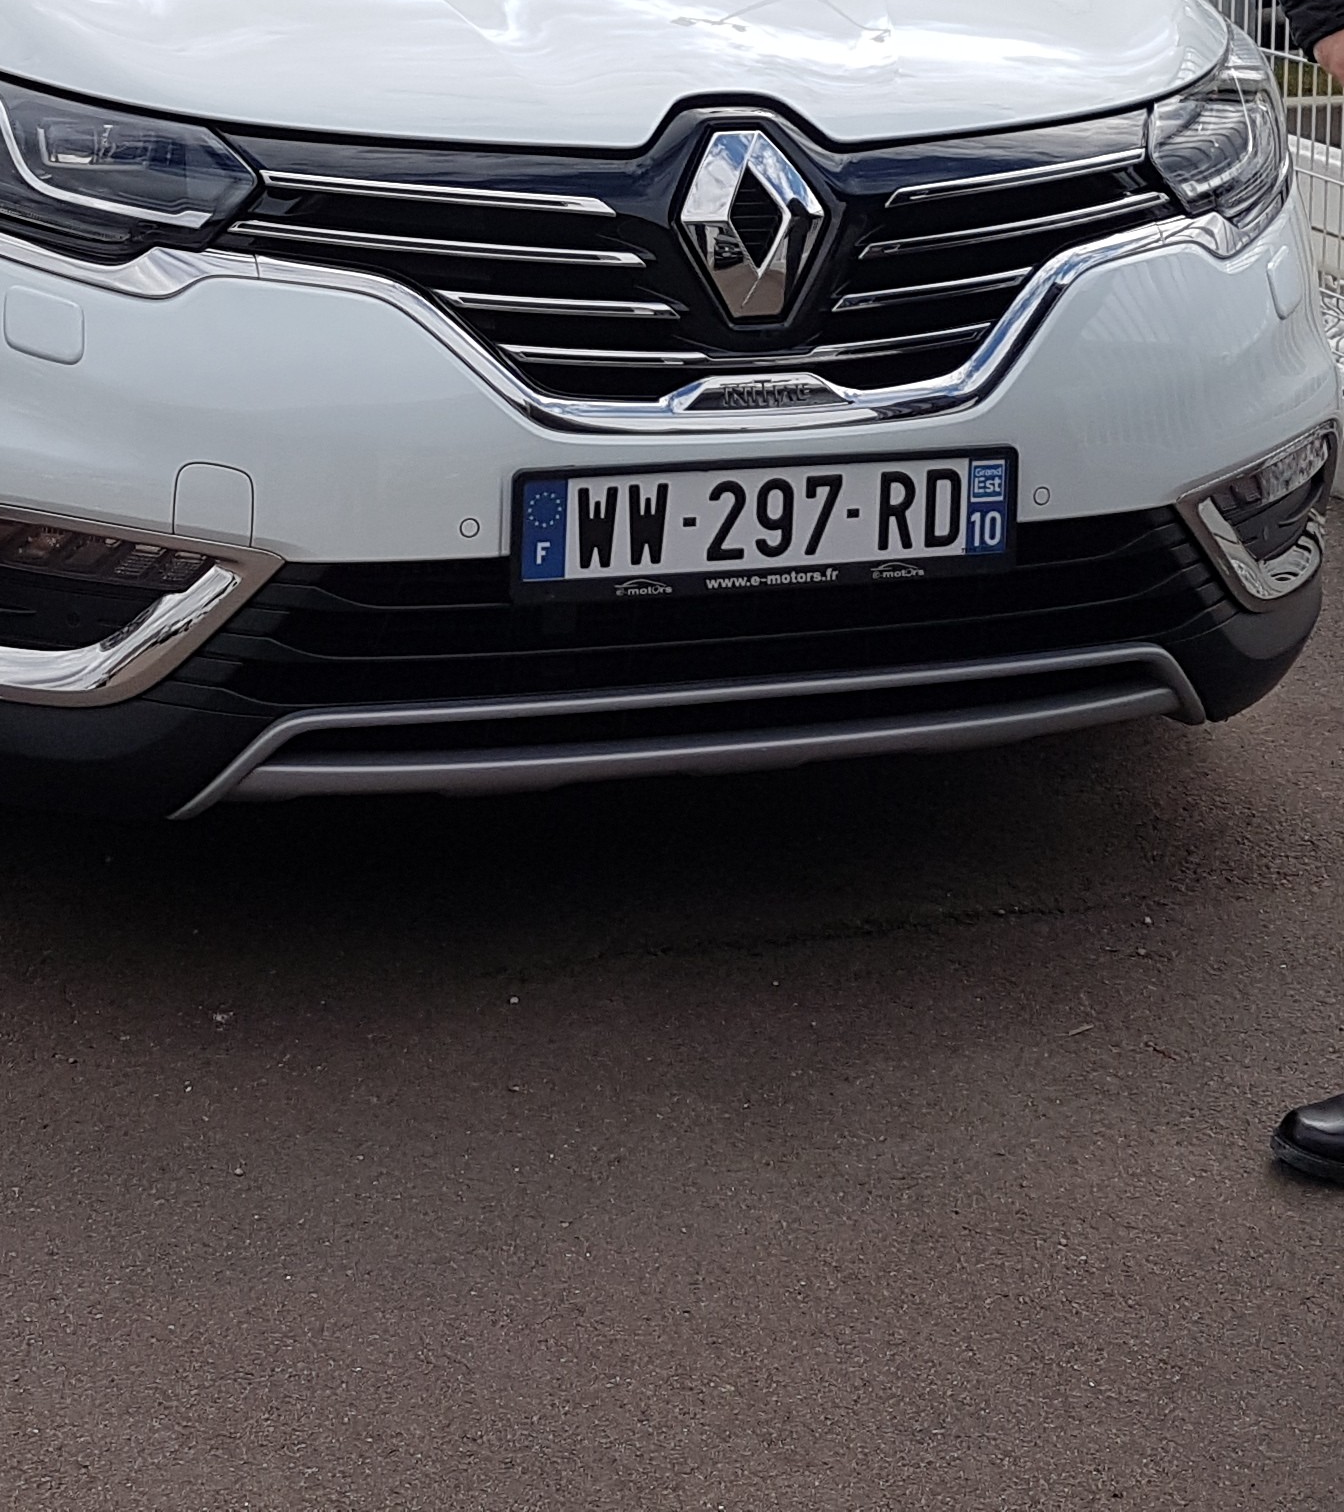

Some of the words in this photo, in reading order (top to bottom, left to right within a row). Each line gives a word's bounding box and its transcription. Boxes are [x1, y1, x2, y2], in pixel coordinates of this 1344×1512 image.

[974, 467, 1002, 477] Grand
[974, 476, 1002, 493] Est
[577, 467, 962, 570] WW-297-RD
[970, 510, 1002, 547] 10
[536, 541, 551, 566] F
[706, 568, 840, 589] www.e-motors.fr
